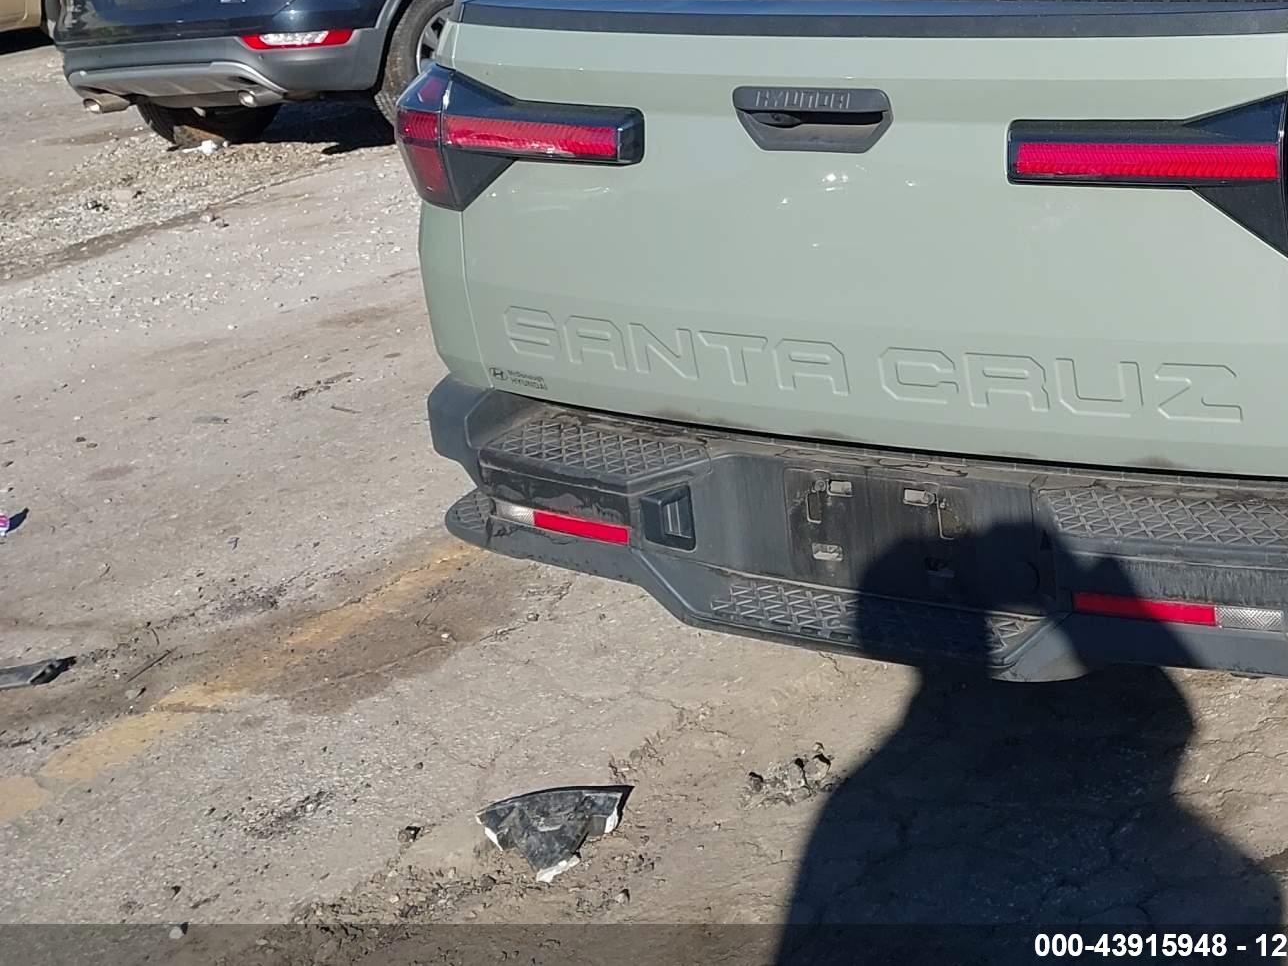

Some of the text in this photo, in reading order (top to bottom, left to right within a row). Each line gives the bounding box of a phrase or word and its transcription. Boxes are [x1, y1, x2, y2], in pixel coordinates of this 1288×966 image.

[756, 90, 851, 109] HYUNDAI
[503, 305, 1243, 423] SANTA CRUZ
